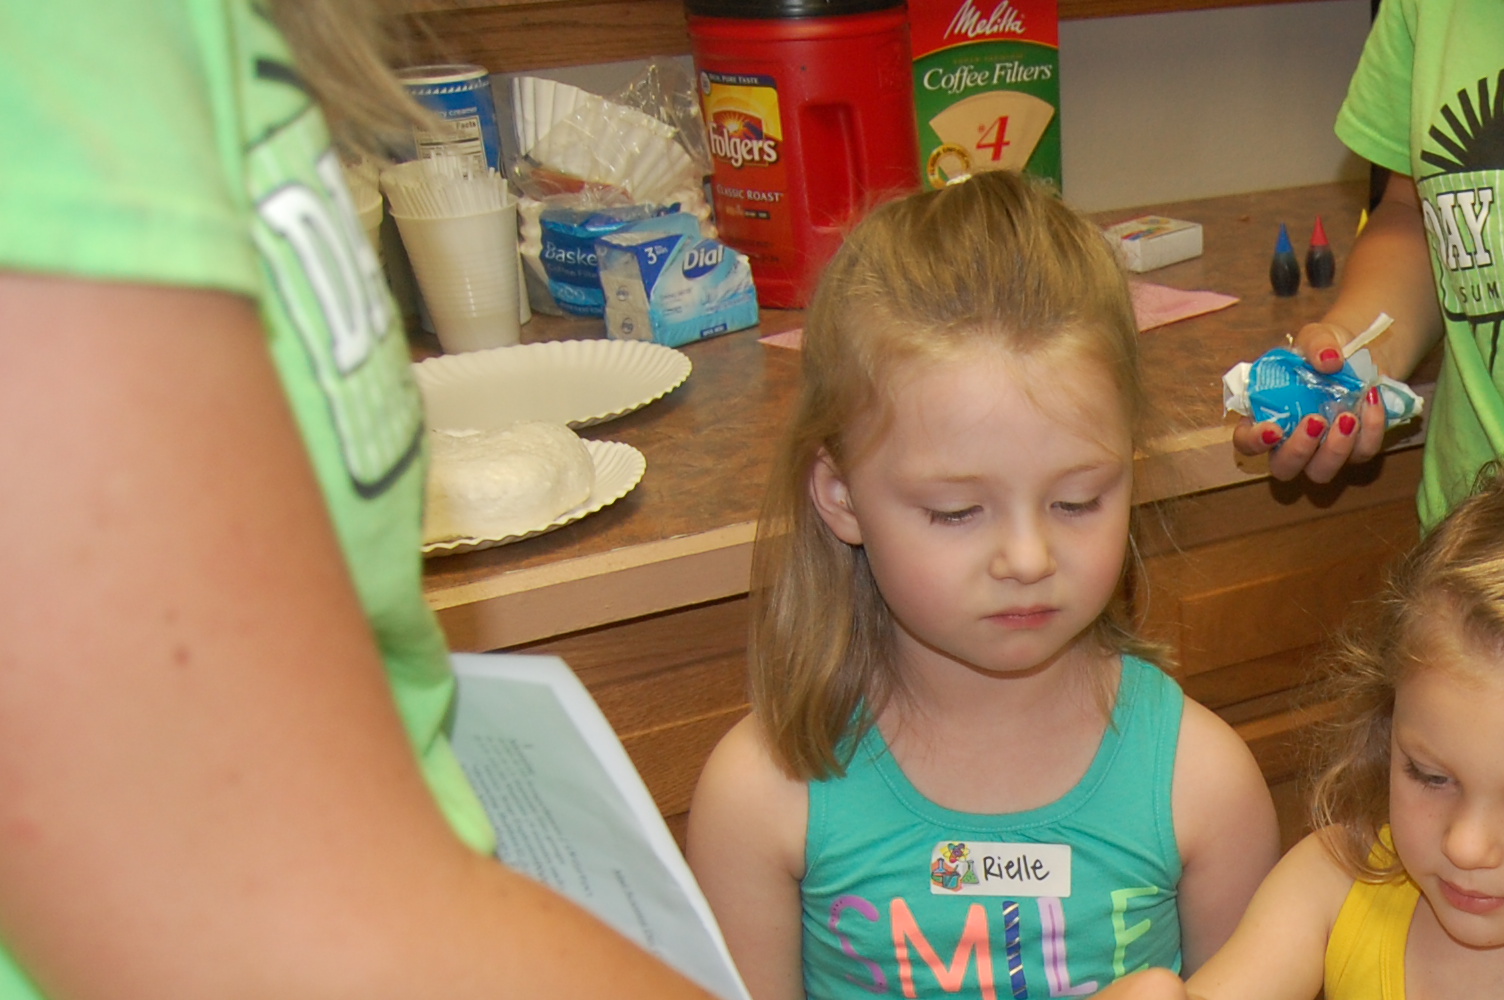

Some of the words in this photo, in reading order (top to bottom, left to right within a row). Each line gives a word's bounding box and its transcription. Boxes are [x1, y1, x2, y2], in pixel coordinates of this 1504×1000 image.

[943, 0, 1026, 40] Melitta
[923, 64, 990, 94] Coffee
[992, 61, 1053, 85] Filters
[709, 122, 778, 168] Folgers
[716, 184, 744, 199] CLASSIC
[746, 189, 781, 202] ROAST
[544, 241, 598, 267] Baske
[643, 246, 658, 265] 3
[682, 244, 725, 272] Dial
[982, 855, 1050, 882] Rielle
